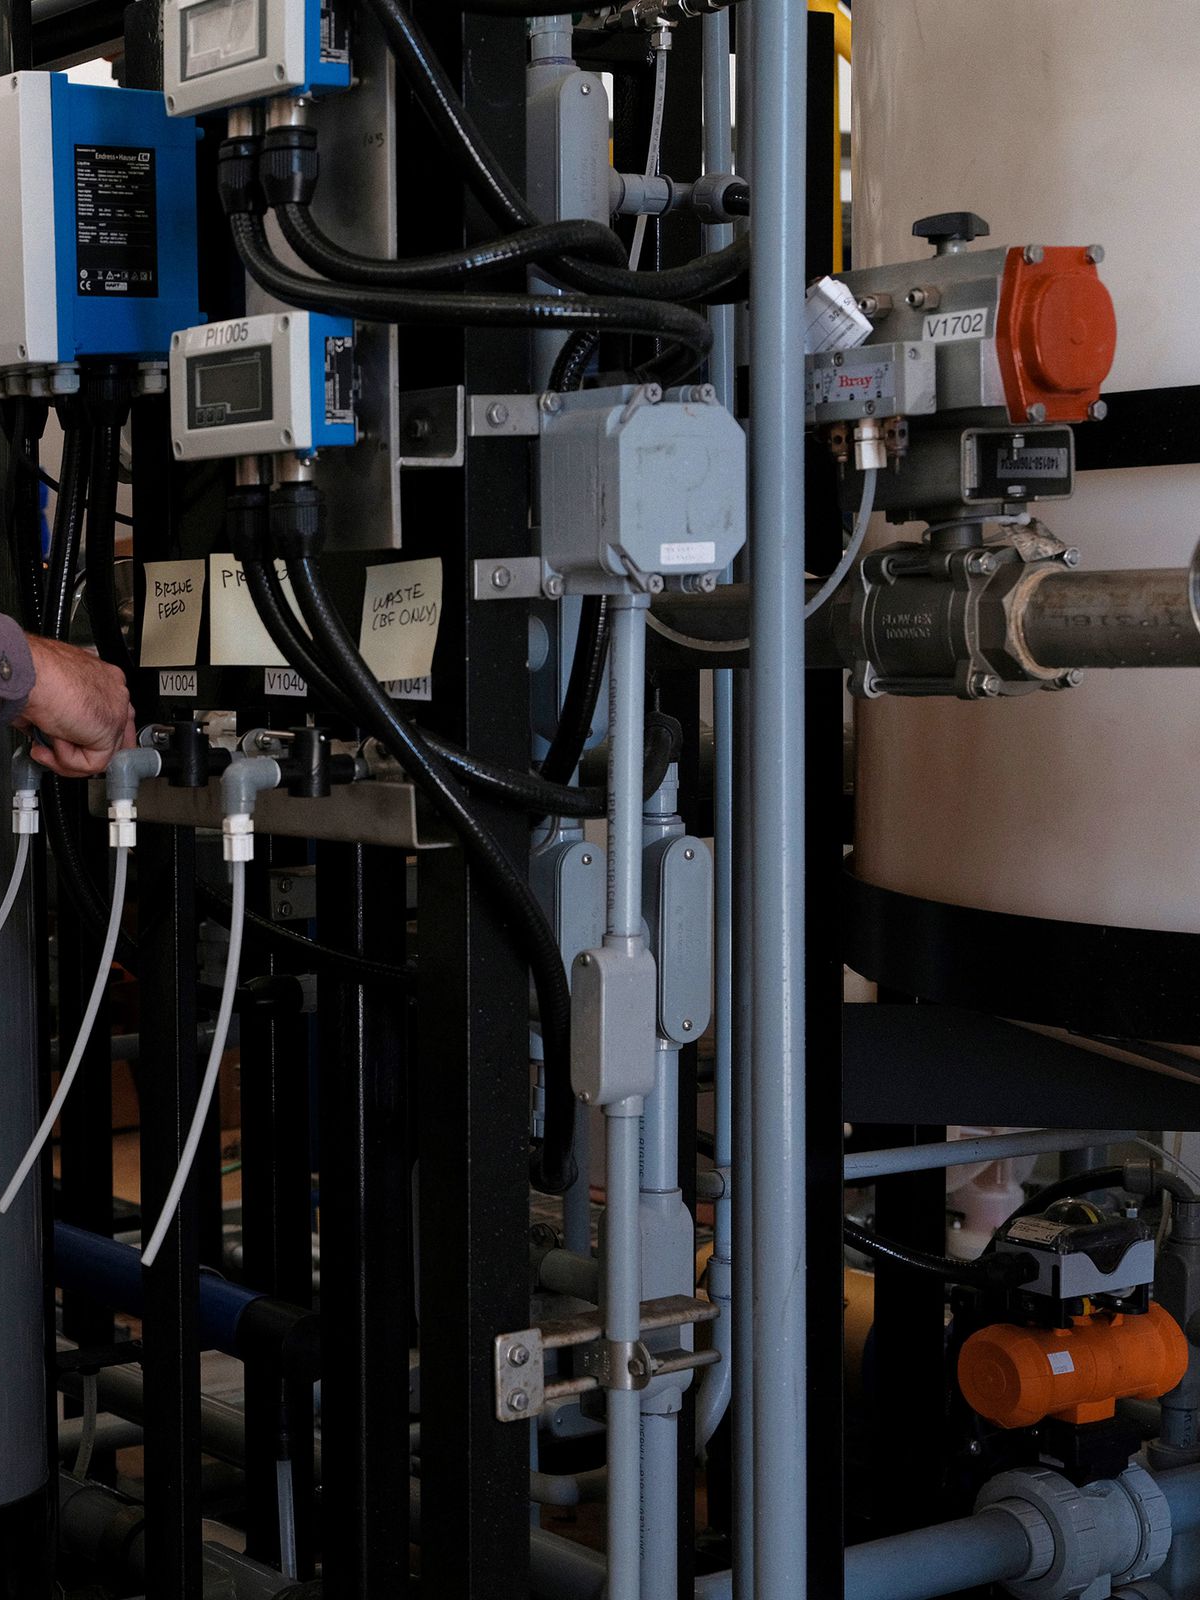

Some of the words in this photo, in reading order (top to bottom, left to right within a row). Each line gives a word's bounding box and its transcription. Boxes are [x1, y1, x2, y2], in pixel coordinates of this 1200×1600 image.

[205, 321, 249, 347] PI1005
[927, 313, 984, 338] V1702
[838, 375, 873, 389] Bray
[154, 578, 194, 598] BRINE
[372, 583, 425, 613] WASTE
[158, 599, 186, 620] FEED
[372, 612, 396, 631] (BF
[399, 602, 437, 627] ONLY)
[160, 674, 196, 692] V1004
[267, 672, 306, 692] V1040
[388, 678, 428, 695] V1041
